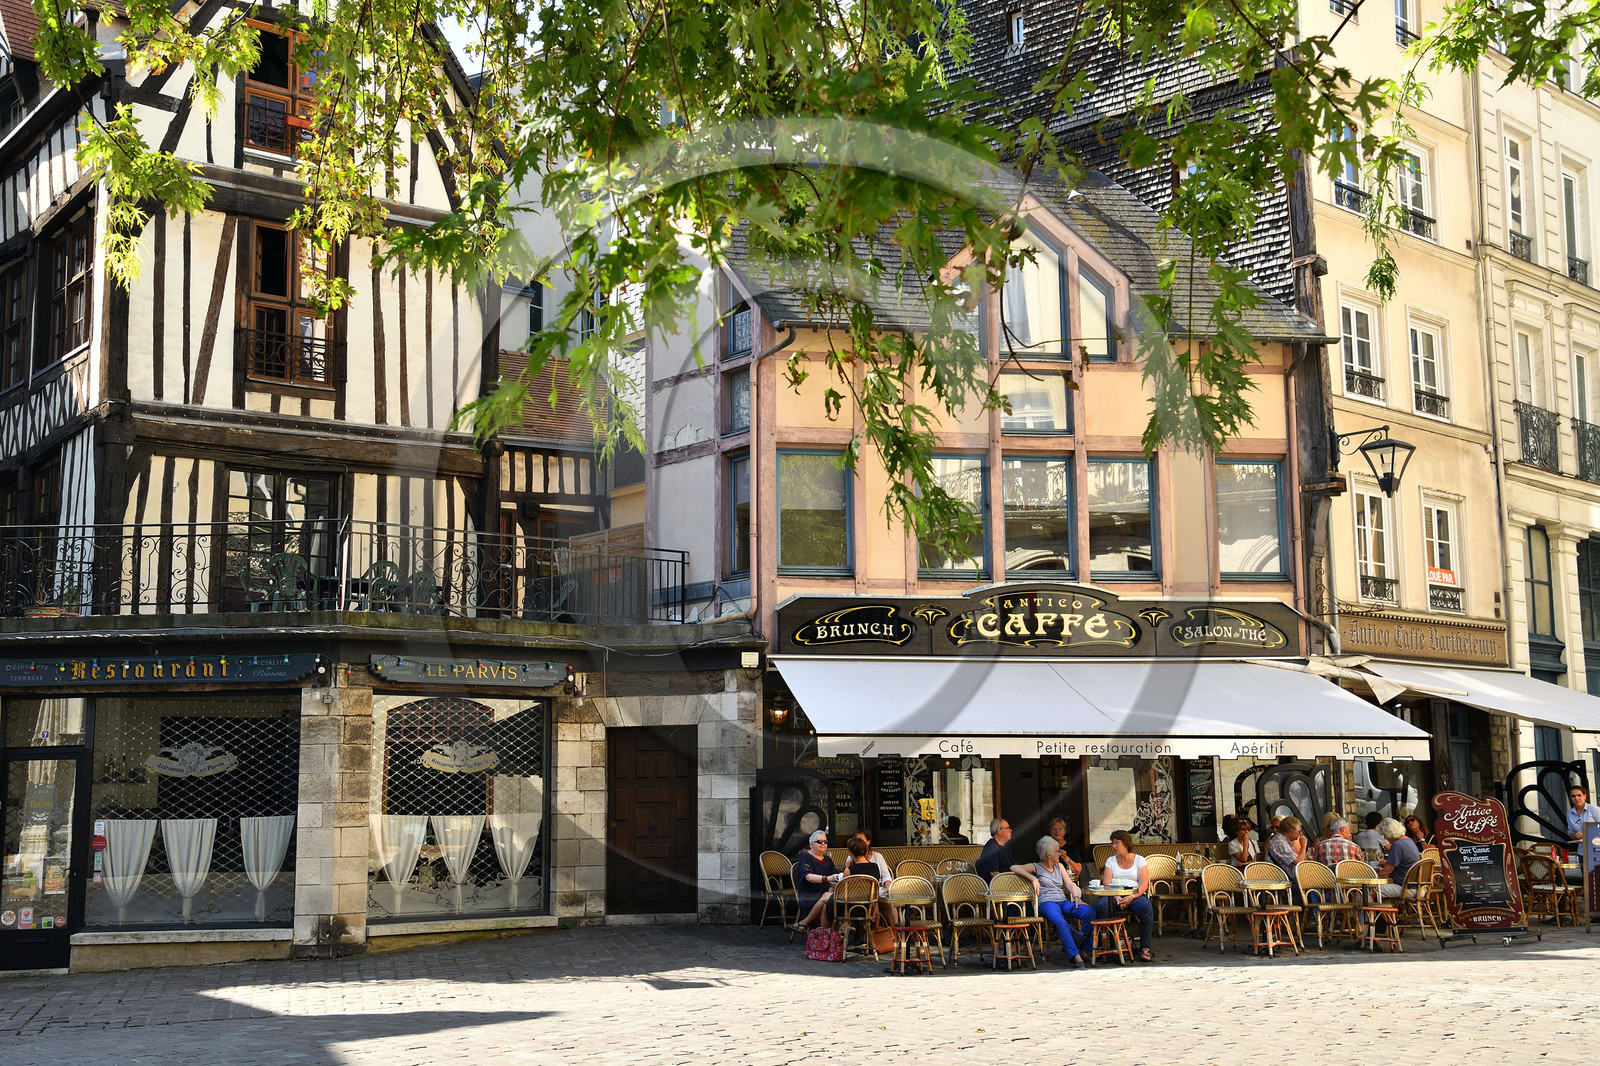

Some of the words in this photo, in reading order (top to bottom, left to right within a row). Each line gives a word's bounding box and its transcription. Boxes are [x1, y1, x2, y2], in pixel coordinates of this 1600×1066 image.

[1442, 573, 1454, 583] PAR
[1003, 598, 1082, 609] ANTICO
[816, 622, 894, 640] BRUNCH
[1184, 626, 1232, 640] SALON
[1239, 627, 1268, 641] THÉ
[1349, 619, 1391, 647] Antico
[1394, 624, 1425, 653] Caffé
[1428, 626, 1498, 661] Barthélémy
[6, 663, 49, 671] Déjeuers
[70, 660, 230, 680] Restaurant
[427, 664, 447, 677] LE
[455, 664, 518, 680] PARVIS
[938, 739, 974, 753] Café
[1036, 741, 1076, 753] Petite
[1085, 741, 1172, 754] restauration
[1230, 741, 1285, 755] Apéritif
[1342, 742, 1389, 755] Brunch
[1444, 802, 1493, 820] Antico
[1453, 815, 1499, 834] Caffé
